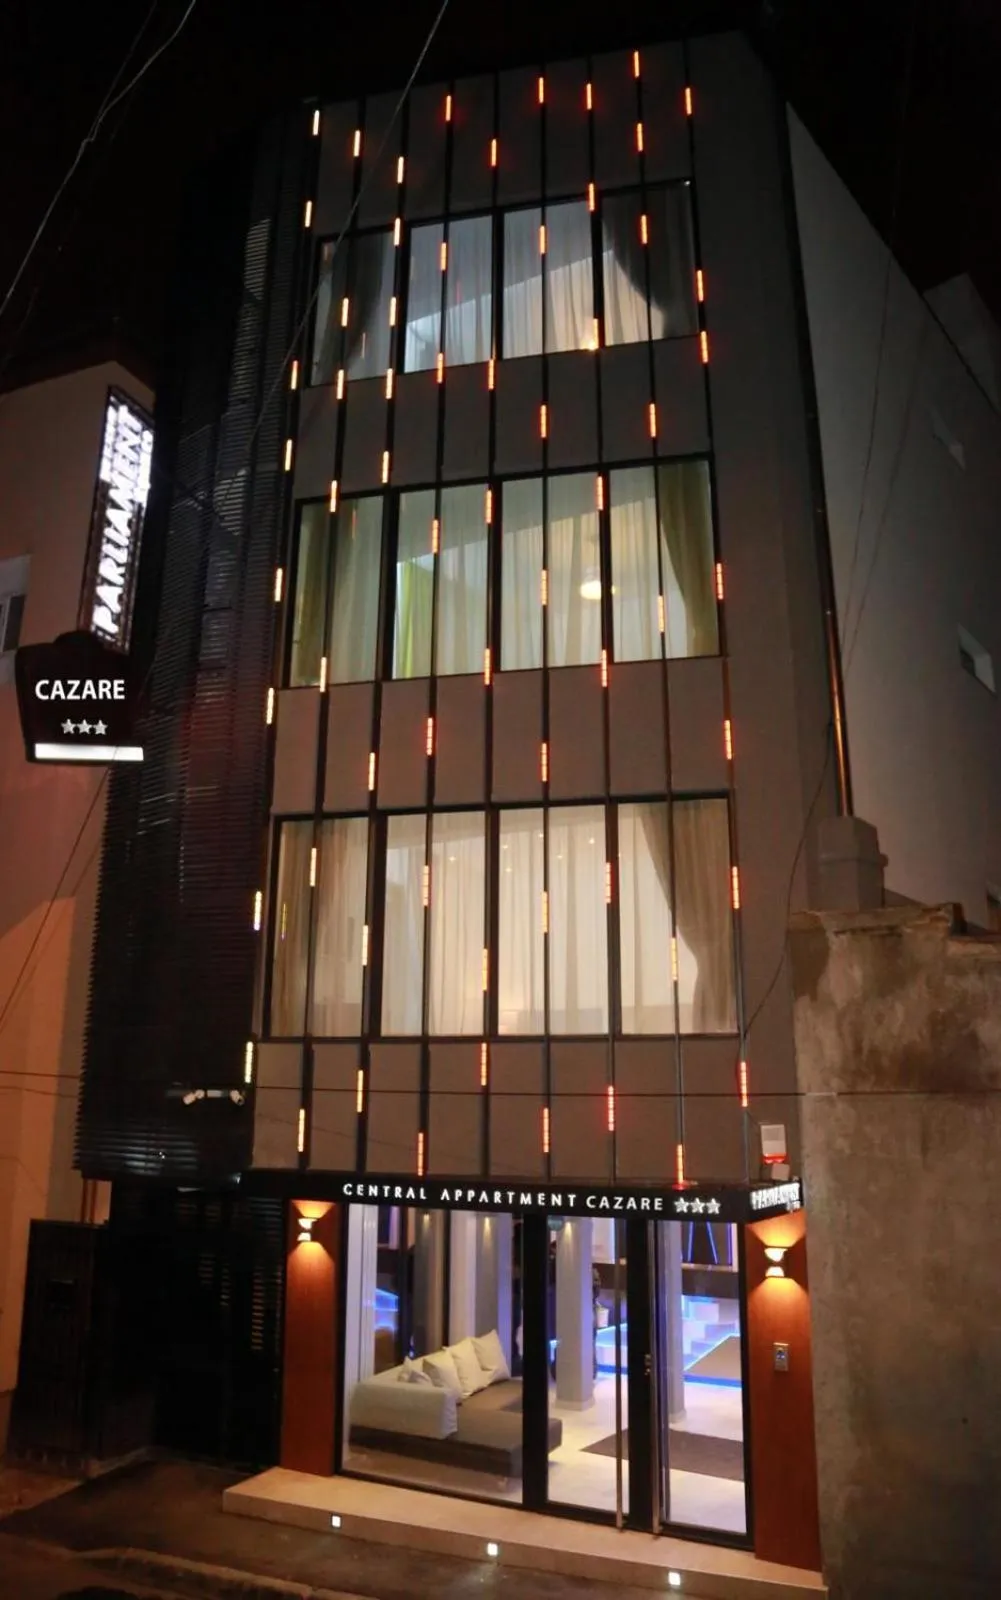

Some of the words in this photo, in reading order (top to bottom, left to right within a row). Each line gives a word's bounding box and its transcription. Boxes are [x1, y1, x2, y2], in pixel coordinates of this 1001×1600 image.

[93, 404, 142, 634] PARLIAMENT
[35, 679, 125, 700] CAZARE
[343, 1183, 427, 1200] CENTRAL
[440, 1188, 576, 1207] APPARTMENT
[586, 1195, 664, 1211] CAZARE
